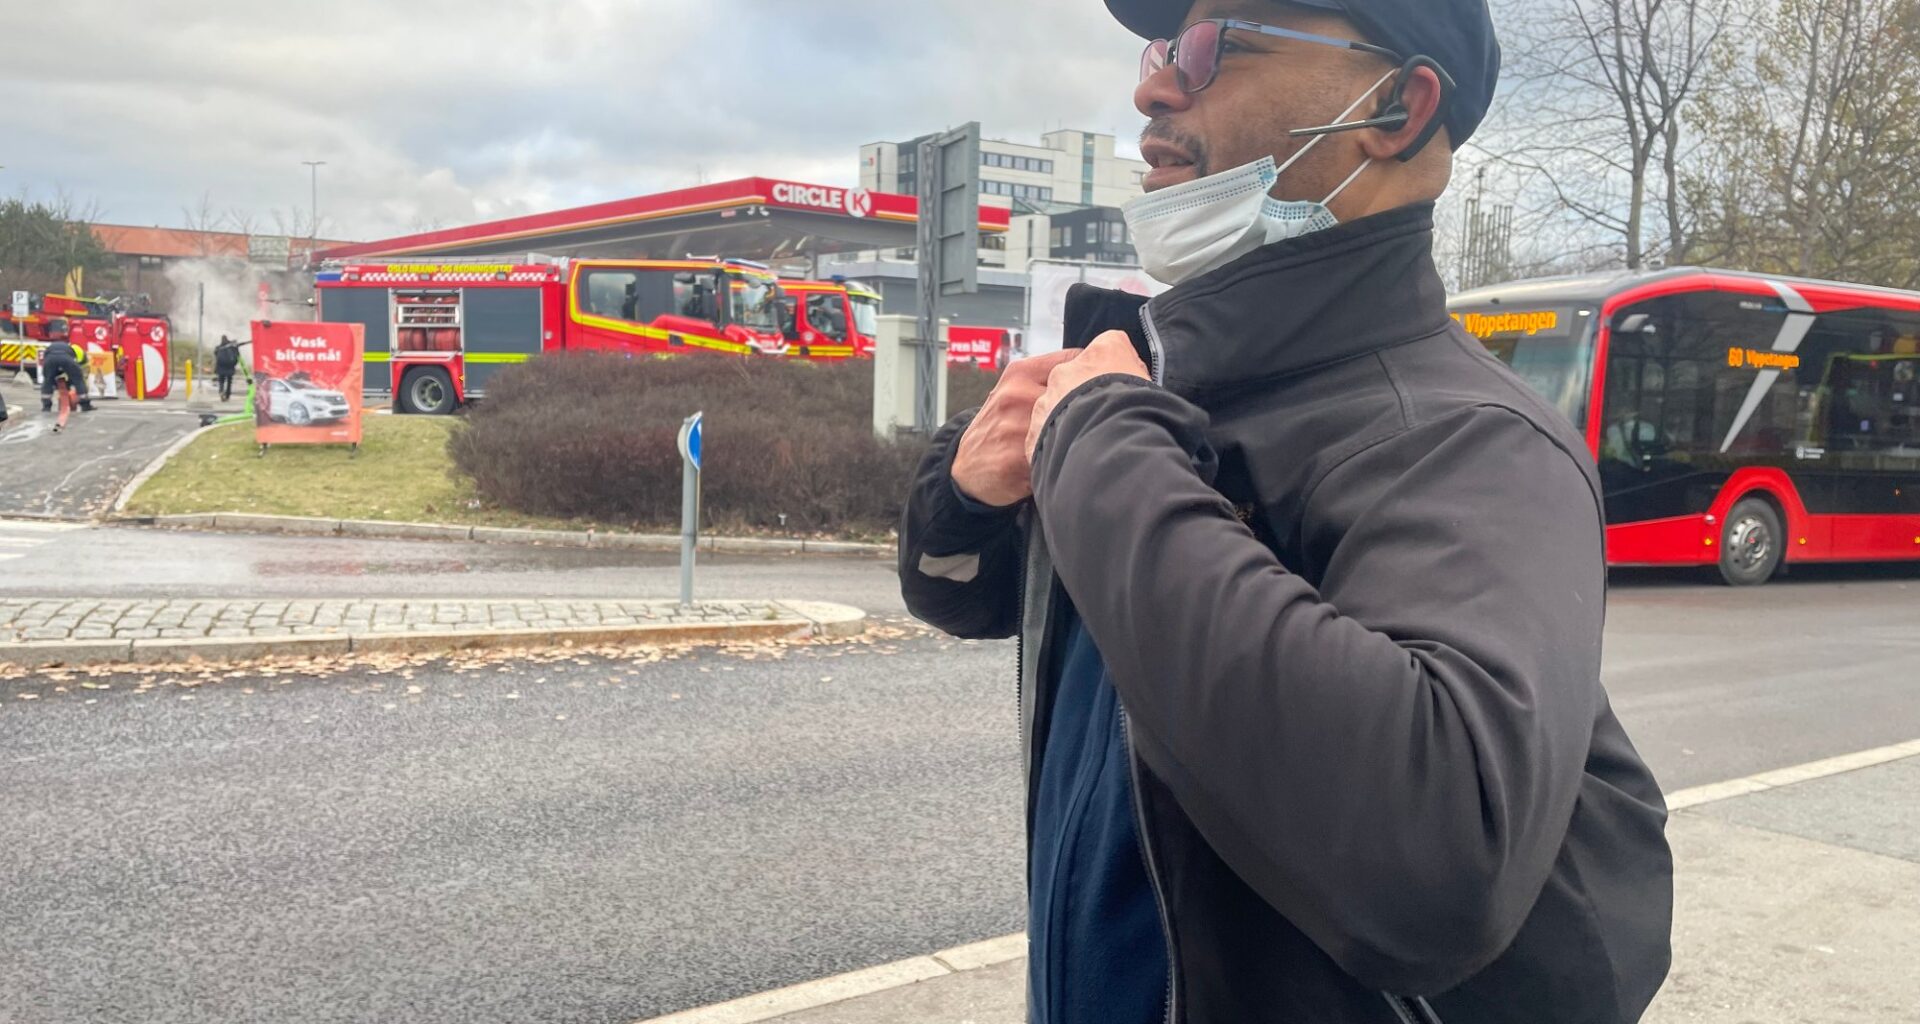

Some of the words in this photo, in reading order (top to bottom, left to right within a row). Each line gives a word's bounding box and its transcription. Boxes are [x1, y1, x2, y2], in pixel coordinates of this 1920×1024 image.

[772, 183, 842, 208] CIRCLE
[846, 188, 870, 215] K
[387, 264, 408, 273] OSLO
[1464, 311, 1556, 337] Vippetangen
[290, 336, 327, 348] Vask
[275, 349, 315, 361] bilen
[317, 348, 341, 361] nå!
[1746, 348, 1799, 370] Vippetangen
